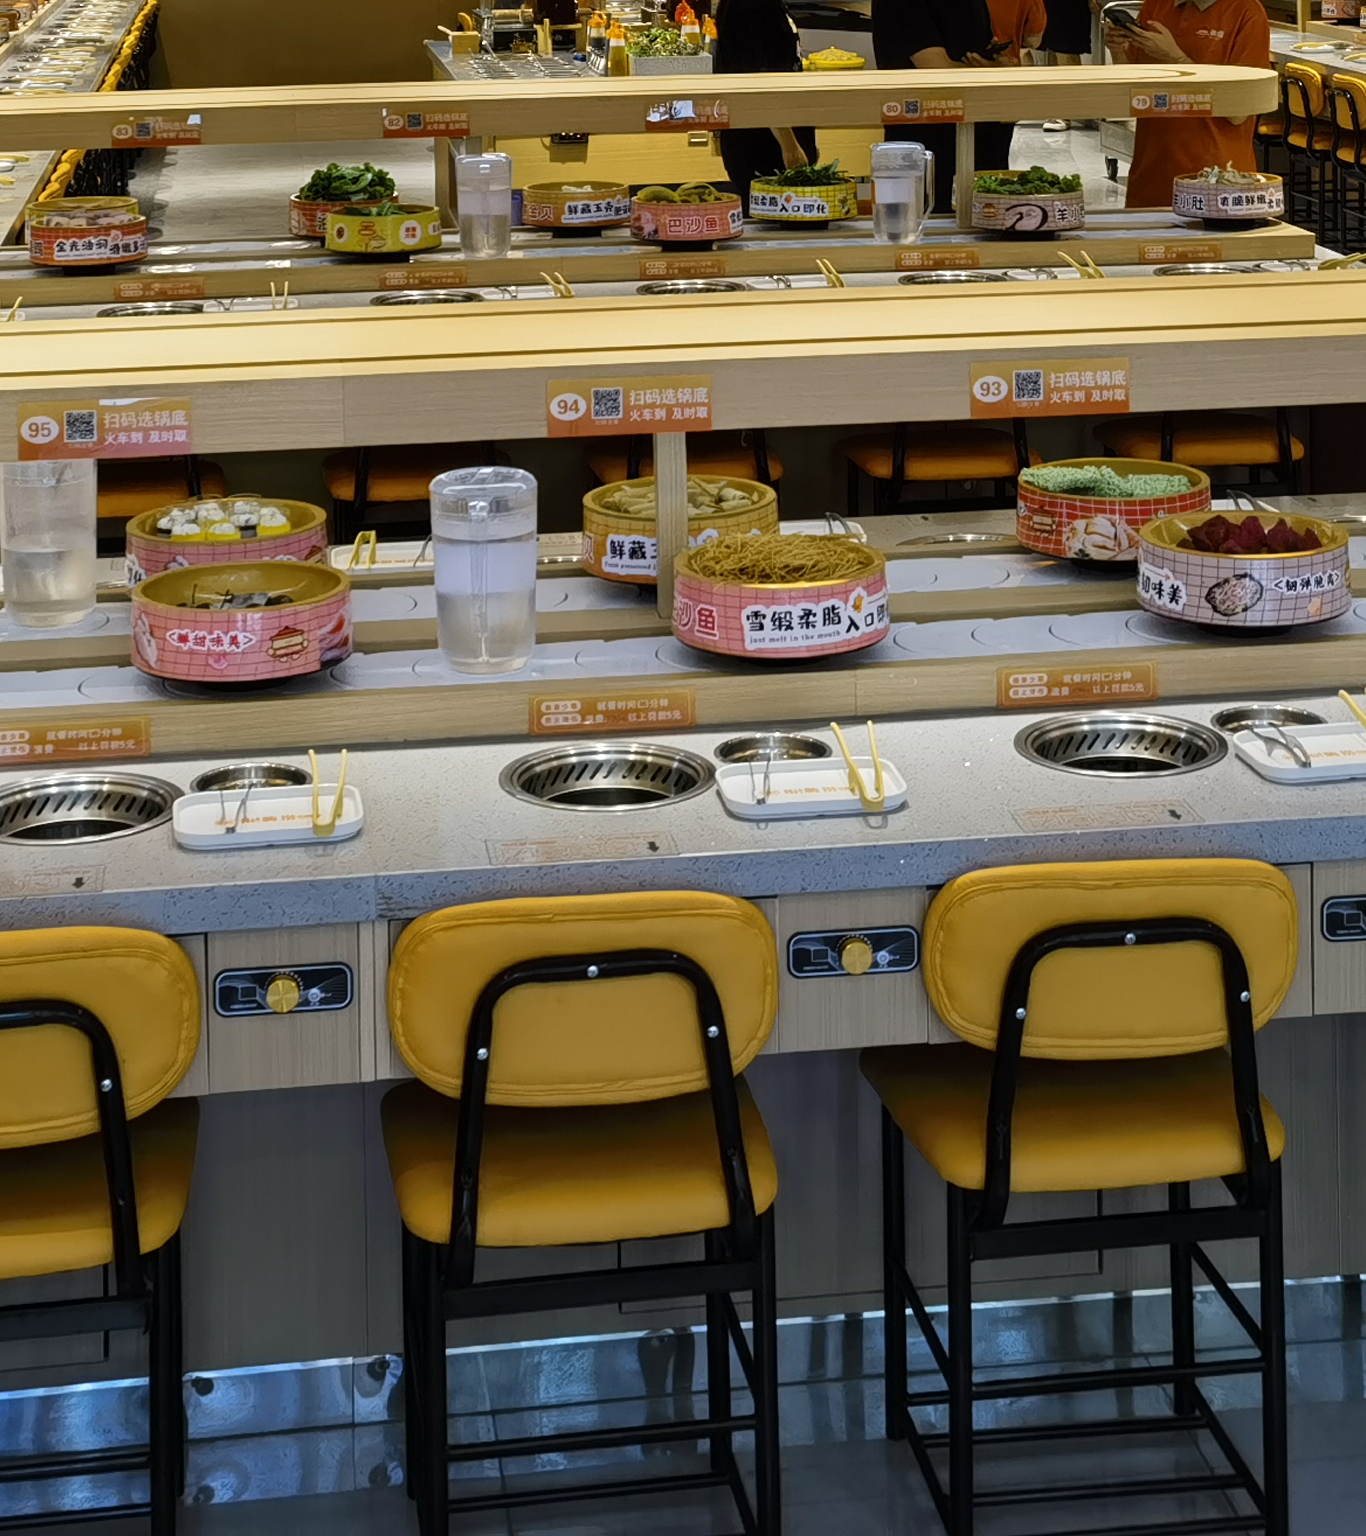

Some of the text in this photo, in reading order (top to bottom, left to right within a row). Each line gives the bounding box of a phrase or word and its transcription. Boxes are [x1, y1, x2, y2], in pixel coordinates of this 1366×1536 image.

[886, 104, 898, 113] 80
[388, 119, 400, 127] 82
[116, 127, 129, 136] 83
[779, 203, 827, 215] 入口即化
[668, 216, 720, 235] 巴沙鱼
[1049, 370, 1126, 388] 扫码选锅底
[629, 387, 709, 406] 扫码选锅底
[979, 381, 1002, 397] 93
[1049, 390, 1085, 404] 火车到
[557, 399, 581, 415] 94
[629, 408, 667, 422] 火车到
[103, 409, 188, 429] 扫码选锅底
[28, 421, 52, 438] 95
[674, 600, 718, 638] 沙鱼
[745, 603, 887, 634] 雪缎柔脂 入口即
[749, 636, 766, 644] just
[768, 635, 786, 643] melt
[801, 632, 815, 640] the
[817, 630, 842, 640] mouth
